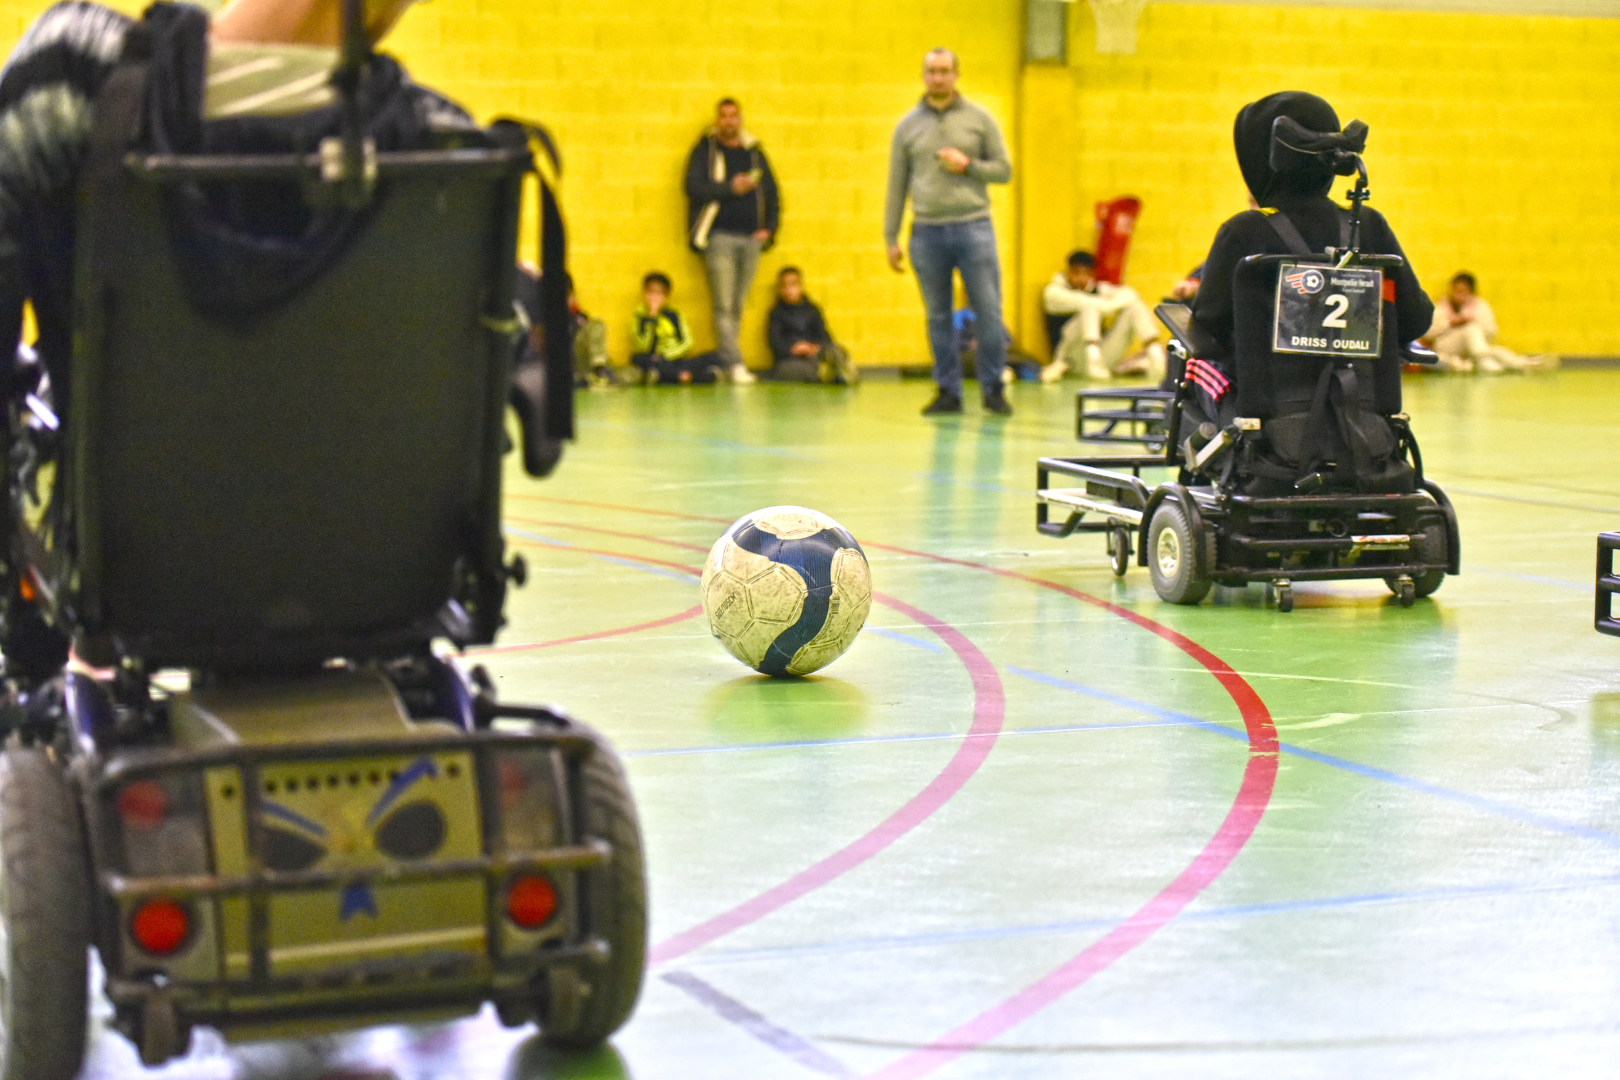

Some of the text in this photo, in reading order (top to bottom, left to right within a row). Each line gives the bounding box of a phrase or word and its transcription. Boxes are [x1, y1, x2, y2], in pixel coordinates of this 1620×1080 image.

[1322, 294, 1349, 328] 2
[1291, 336, 1369, 350] DRISS OUDALI
